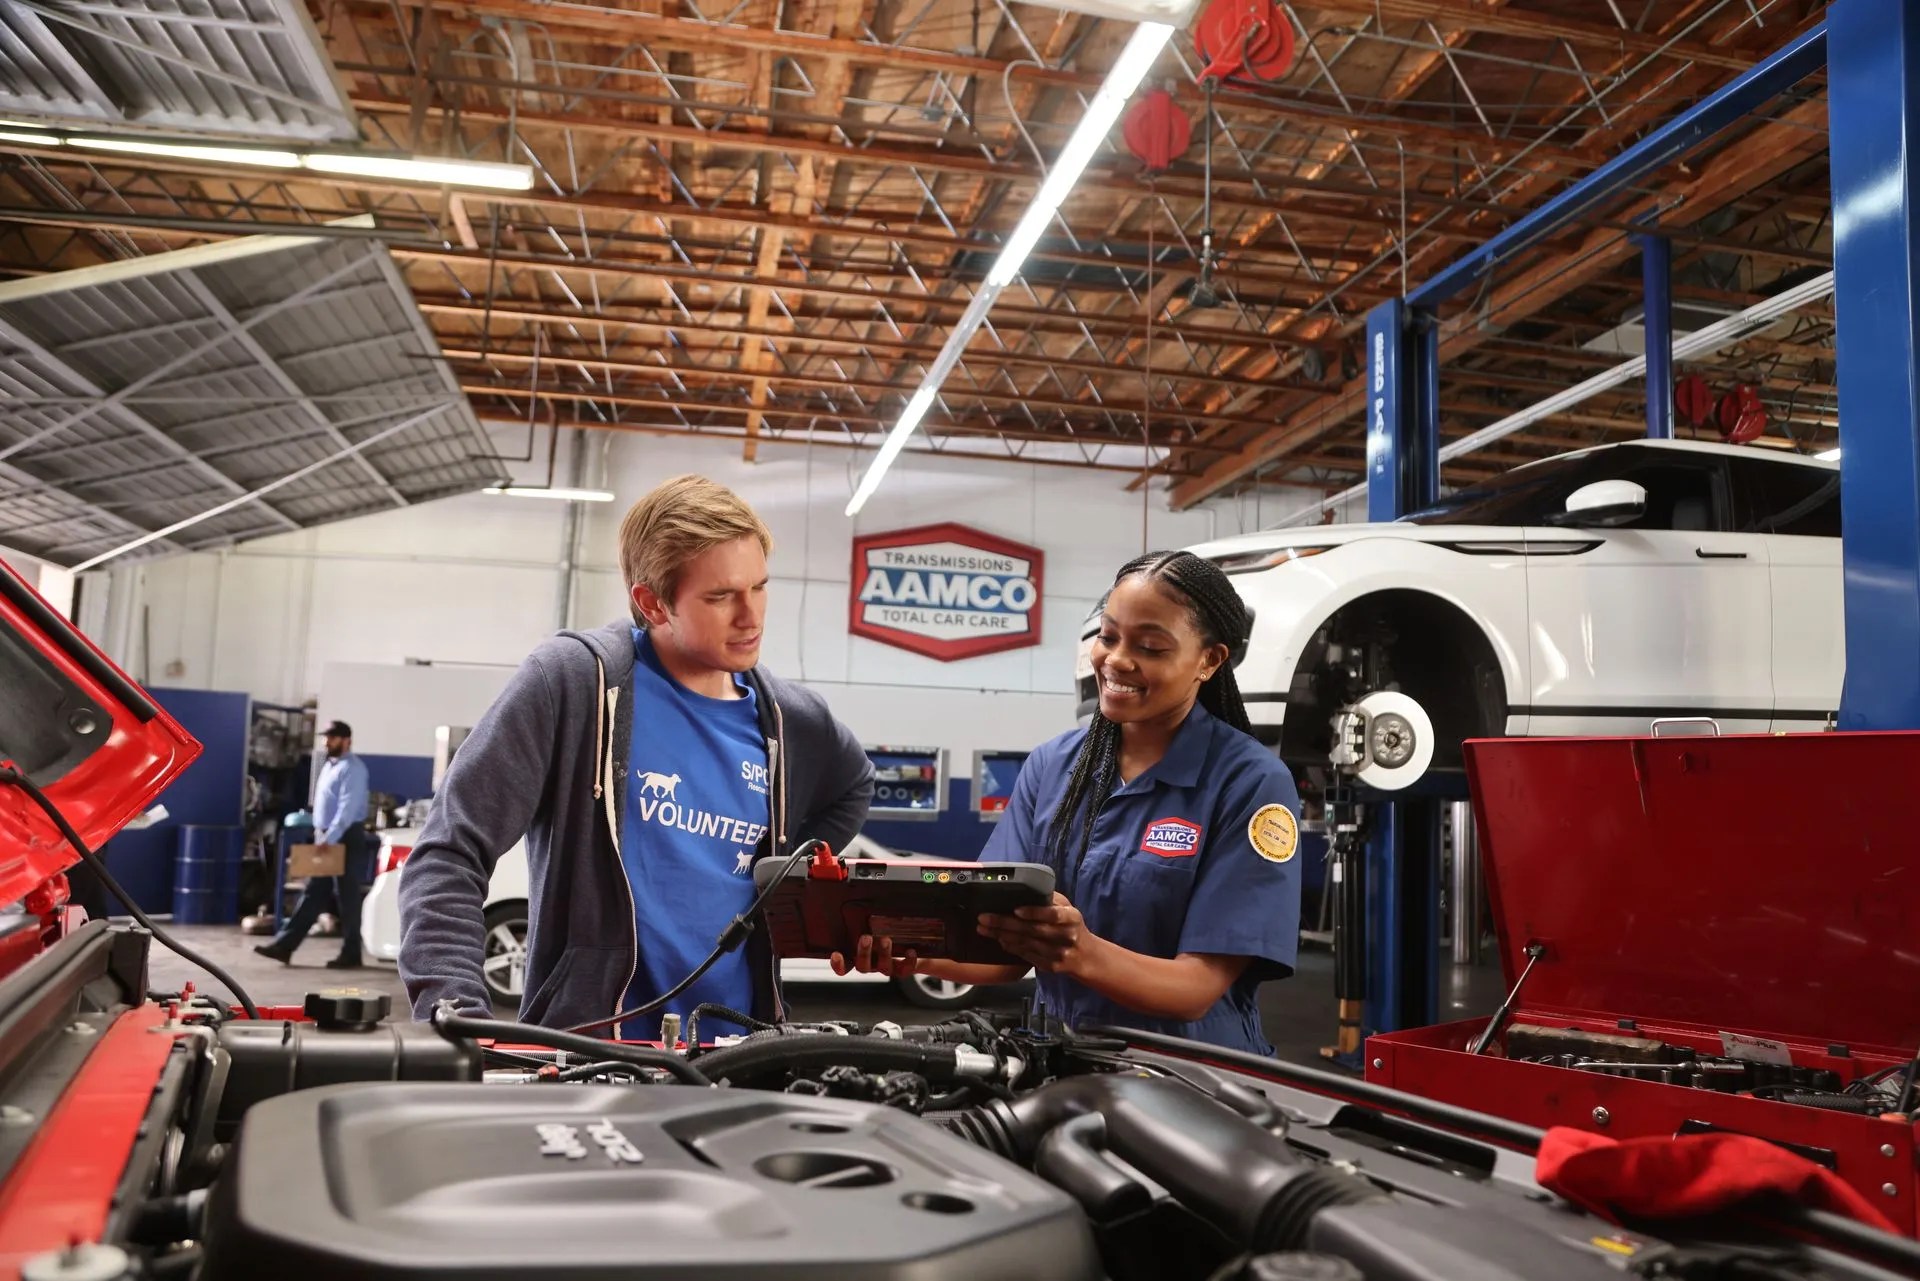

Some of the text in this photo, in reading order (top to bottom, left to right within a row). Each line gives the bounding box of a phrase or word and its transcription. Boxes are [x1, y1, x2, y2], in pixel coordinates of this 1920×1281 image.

[885, 551, 1013, 572] TRANSMISSIONS
[858, 568, 1037, 612] AAMCO
[881, 609, 1010, 629] TOTAL CAR CARE
[1146, 831, 1198, 844] AAMCO
[1155, 825, 1192, 833] TRANSMISSIONS
